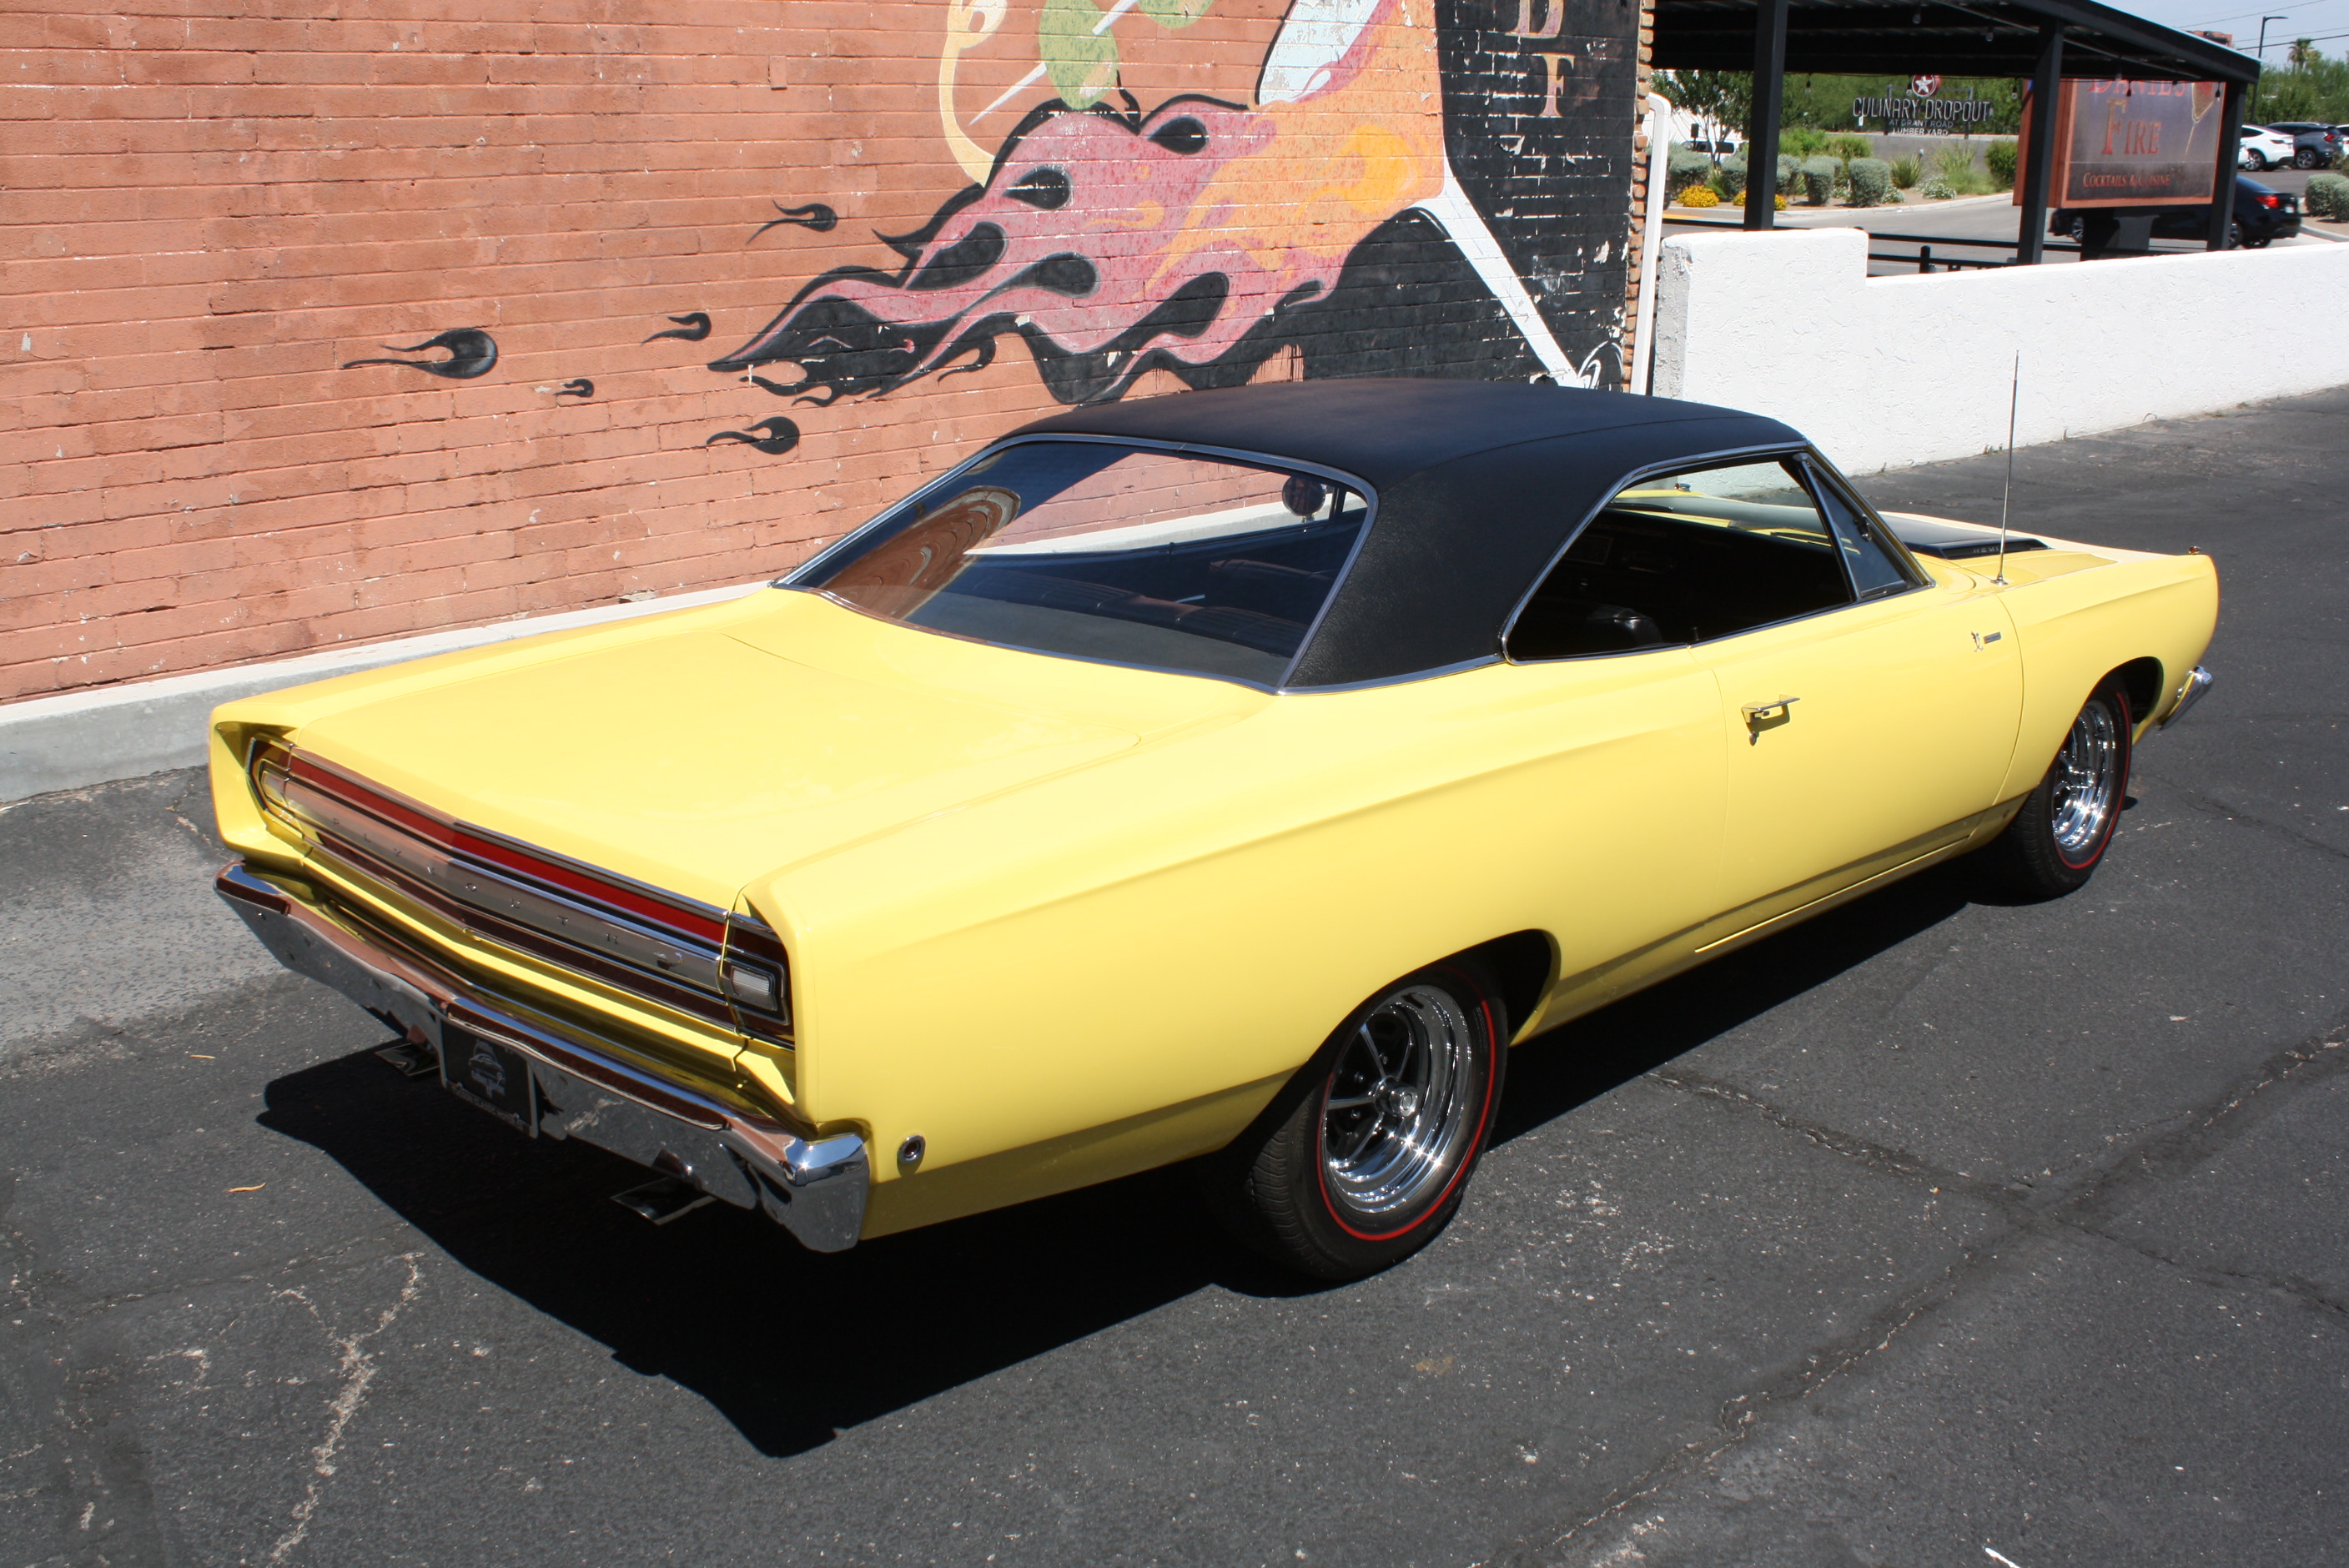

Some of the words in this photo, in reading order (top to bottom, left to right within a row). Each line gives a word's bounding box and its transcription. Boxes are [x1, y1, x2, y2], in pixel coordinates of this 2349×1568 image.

[1538, 53, 1575, 118] F
[1853, 97, 1919, 119] CULINARY
[1925, 99, 1990, 122] DROPOUT
[2101, 99, 2161, 154] FIRE
[2083, 172, 2127, 187] COCKTAILS
[2130, 173, 2136, 186] &
